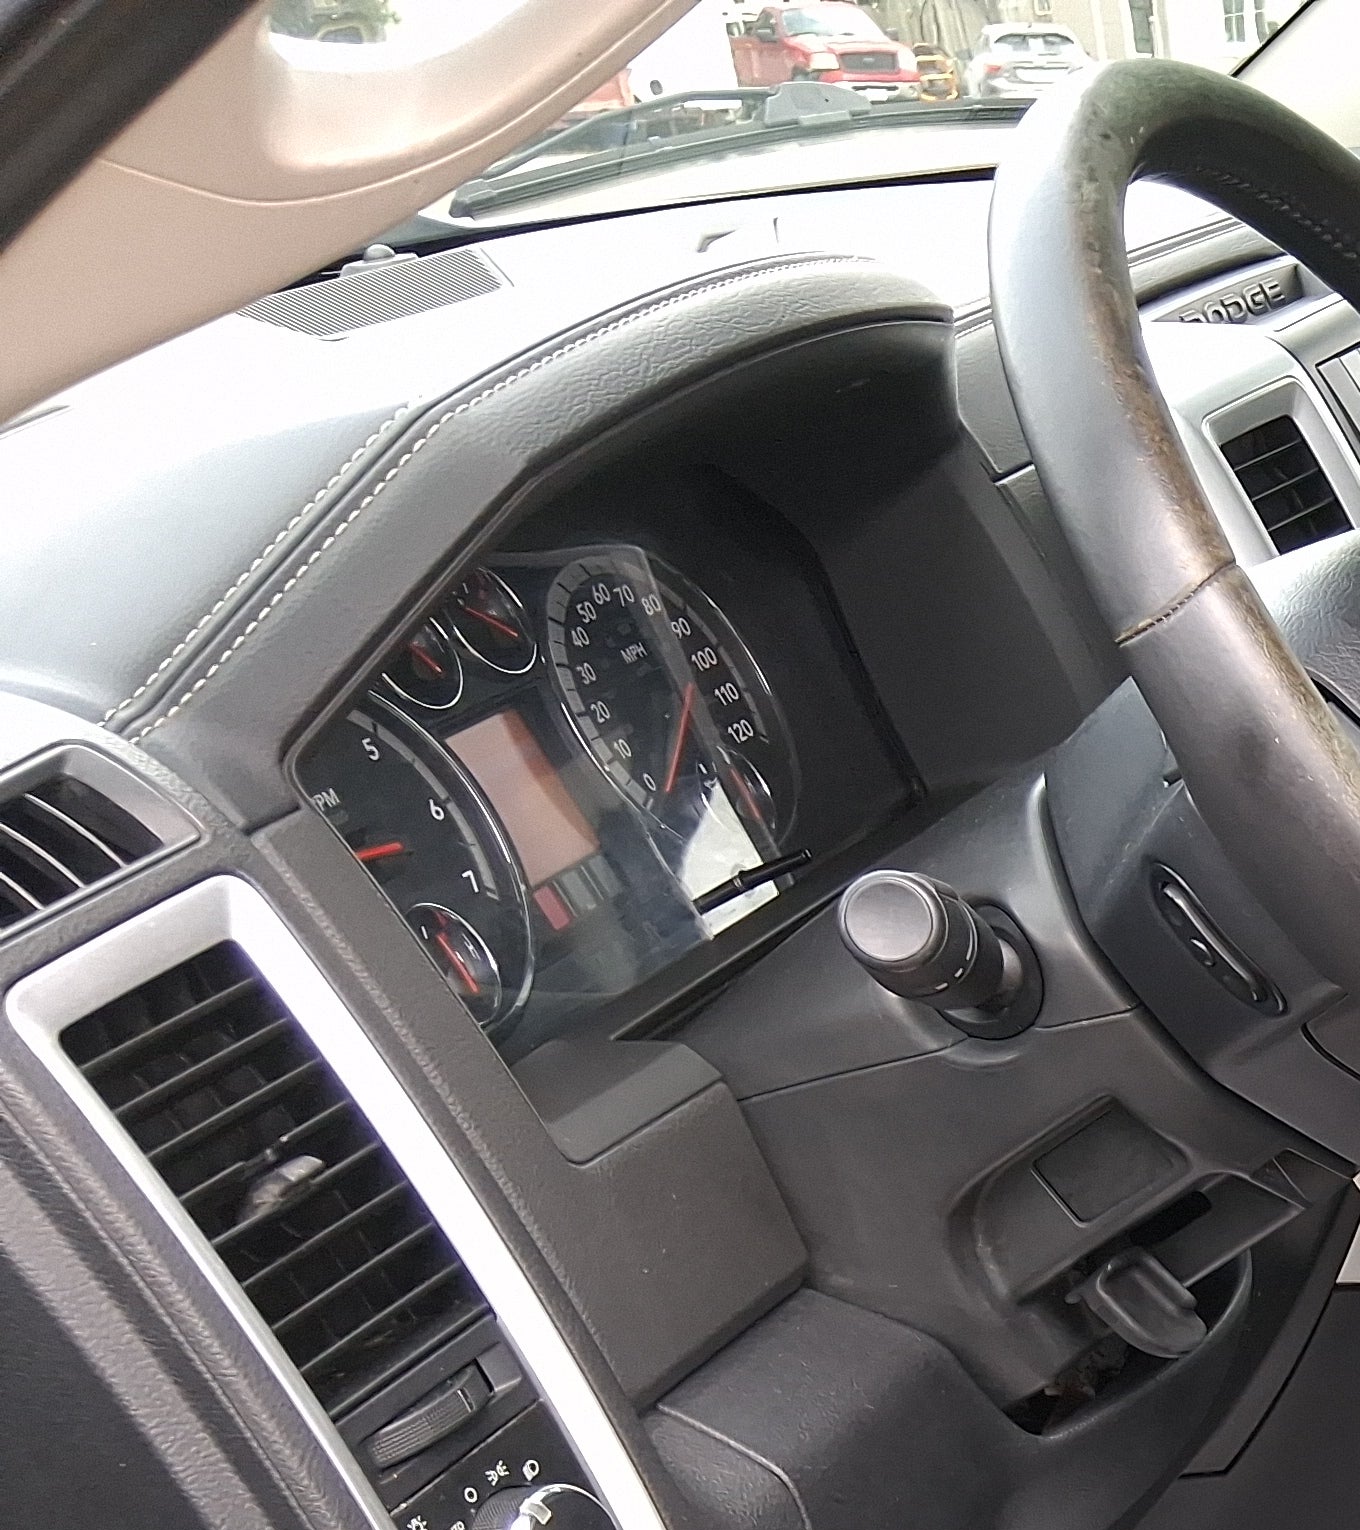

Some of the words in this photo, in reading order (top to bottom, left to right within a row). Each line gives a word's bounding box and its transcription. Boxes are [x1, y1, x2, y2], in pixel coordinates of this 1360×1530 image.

[592, 583, 611, 605] 60
[613, 584, 635, 607] 70
[641, 594, 662, 615] 80
[576, 601, 597, 624] 50
[571, 626, 590, 648] 40
[671, 617, 692, 639] 90
[620, 642, 648, 664] MPH
[691, 647, 718, 672] 100
[576, 662, 597, 685] 30
[714, 682, 740, 706] 110
[590, 701, 611, 724] 20
[727, 719, 754, 744] 120
[361, 738, 379, 761] 5
[613, 738, 632, 759] 10
[642, 773, 656, 791] 0
[312, 787, 341, 811] PM
[428, 798, 444, 821] 6
[461, 869, 479, 893] 7
